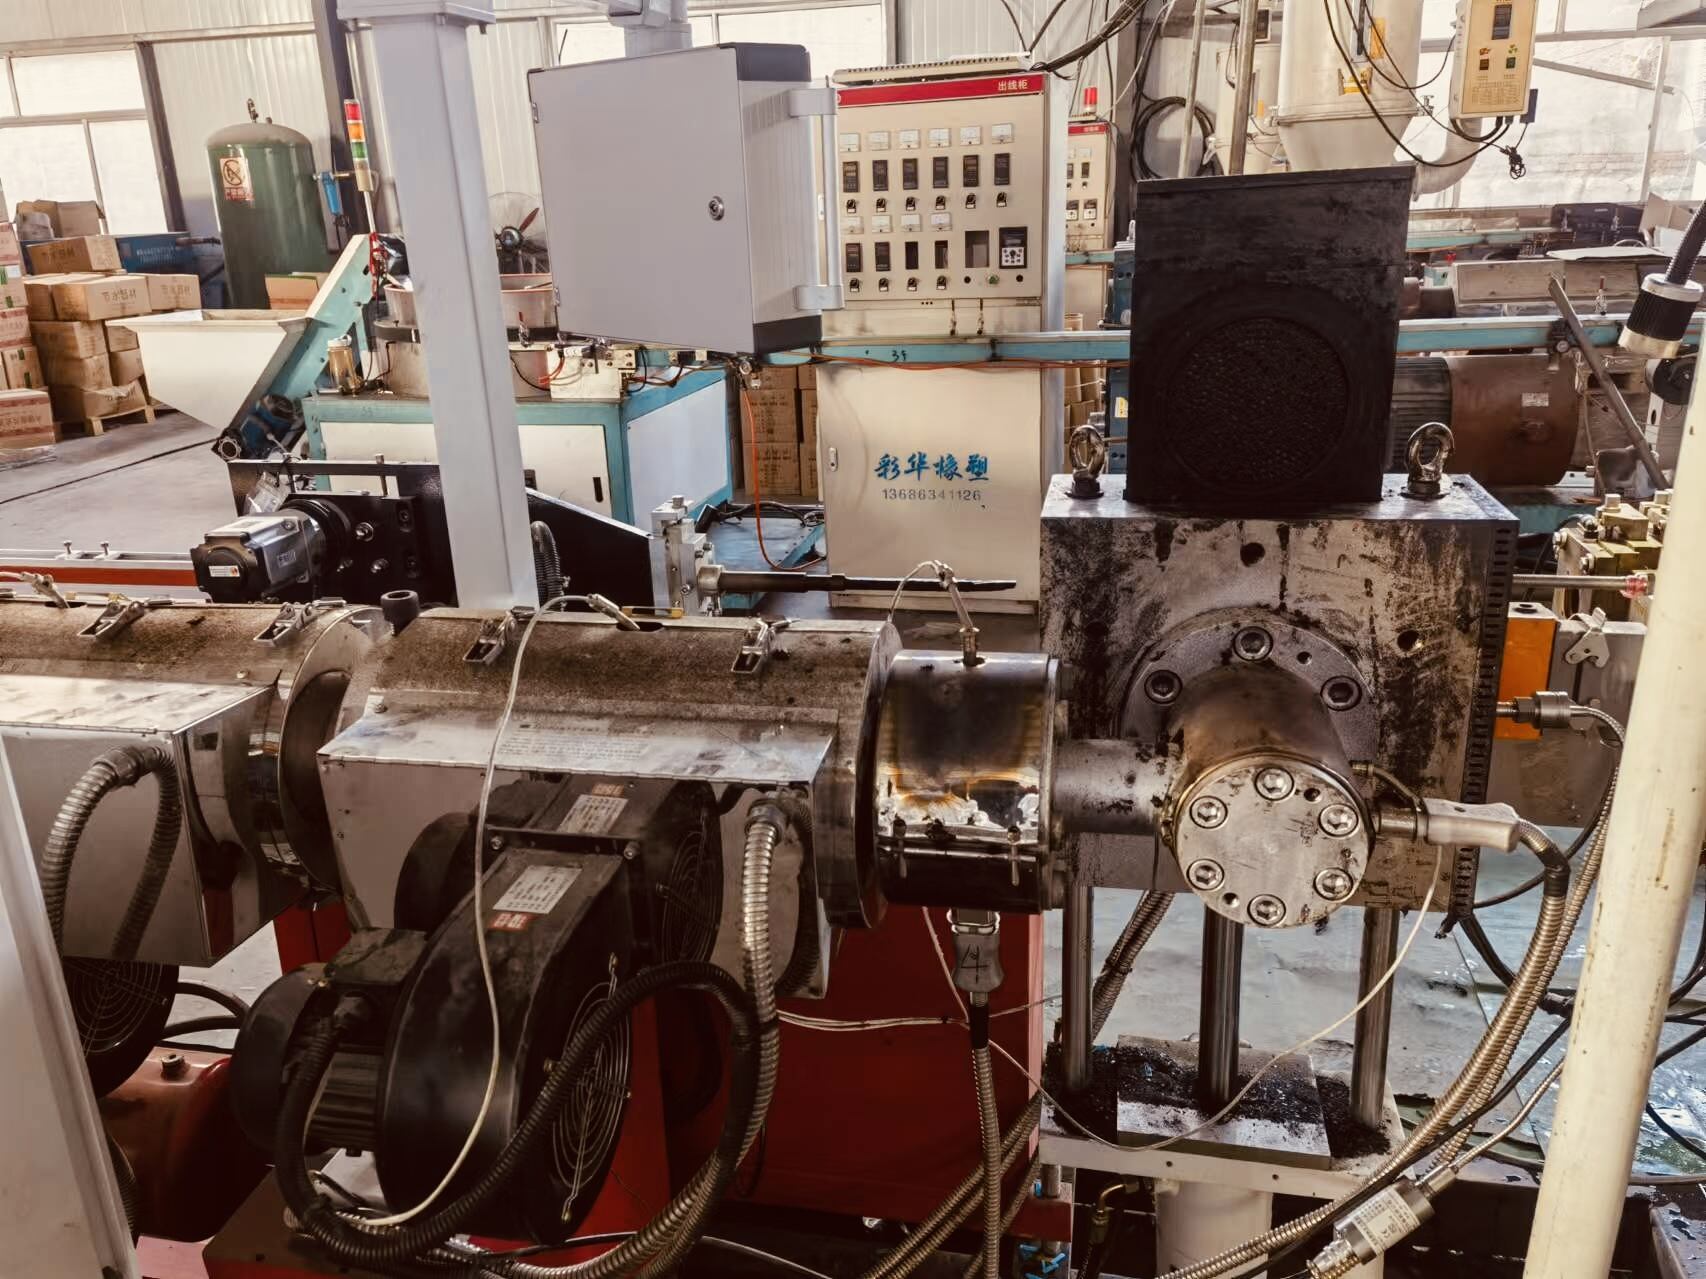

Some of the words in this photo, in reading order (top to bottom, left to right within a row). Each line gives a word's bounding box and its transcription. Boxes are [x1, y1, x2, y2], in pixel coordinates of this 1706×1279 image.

[998, 79, 1028, 91] 出线柜
[874, 451, 990, 482] 彩华橡塑
[881, 488, 982, 501] 13686341126
